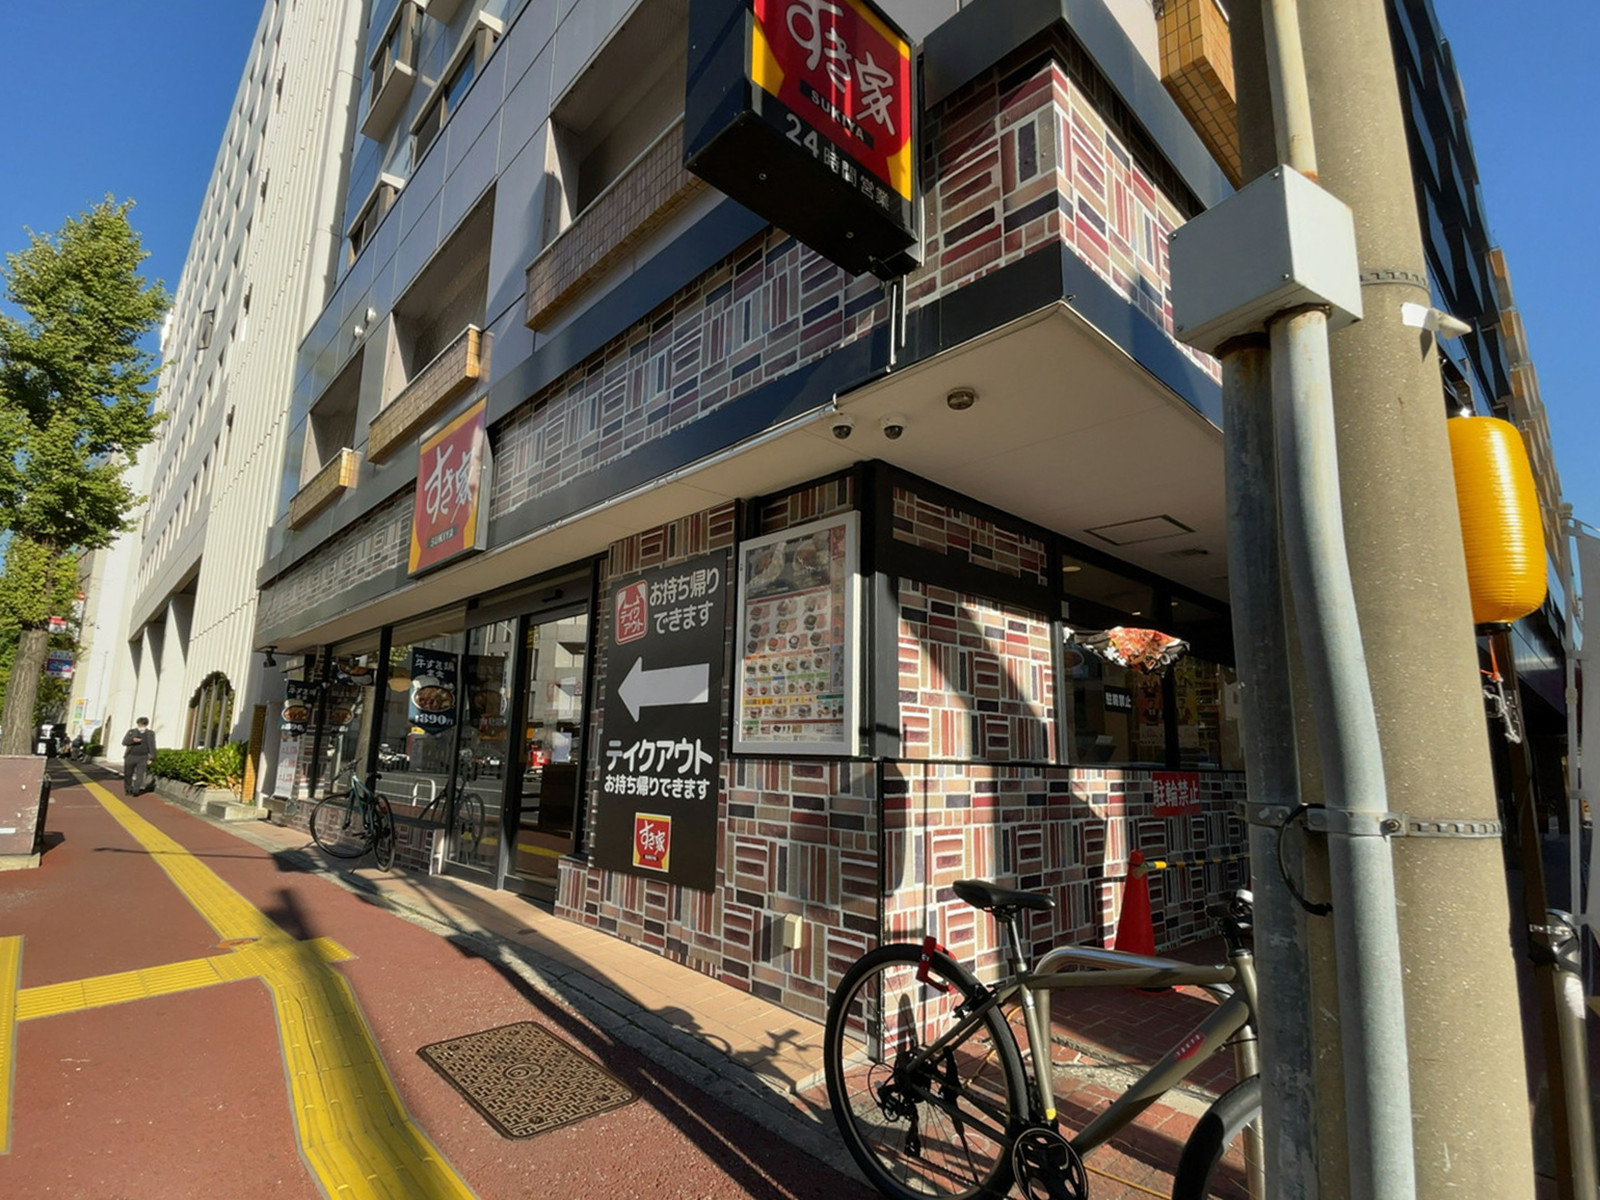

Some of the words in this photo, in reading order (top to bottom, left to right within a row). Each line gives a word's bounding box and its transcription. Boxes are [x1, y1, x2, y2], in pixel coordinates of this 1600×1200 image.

[786, 0, 896, 135] すき家
[810, 90, 865, 141] SUKIYA
[424, 443, 473, 525] すき家
[430, 527, 454, 548] SUKIYA
[649, 566, 720, 608] お持ち帰り
[653, 599, 714, 635] できます
[605, 736, 714, 776] テイクアウト
[603, 774, 711, 801] お持ち帰りできます
[1152, 778, 1201, 809] 駐輪禁止
[639, 819, 666, 855] すき家
